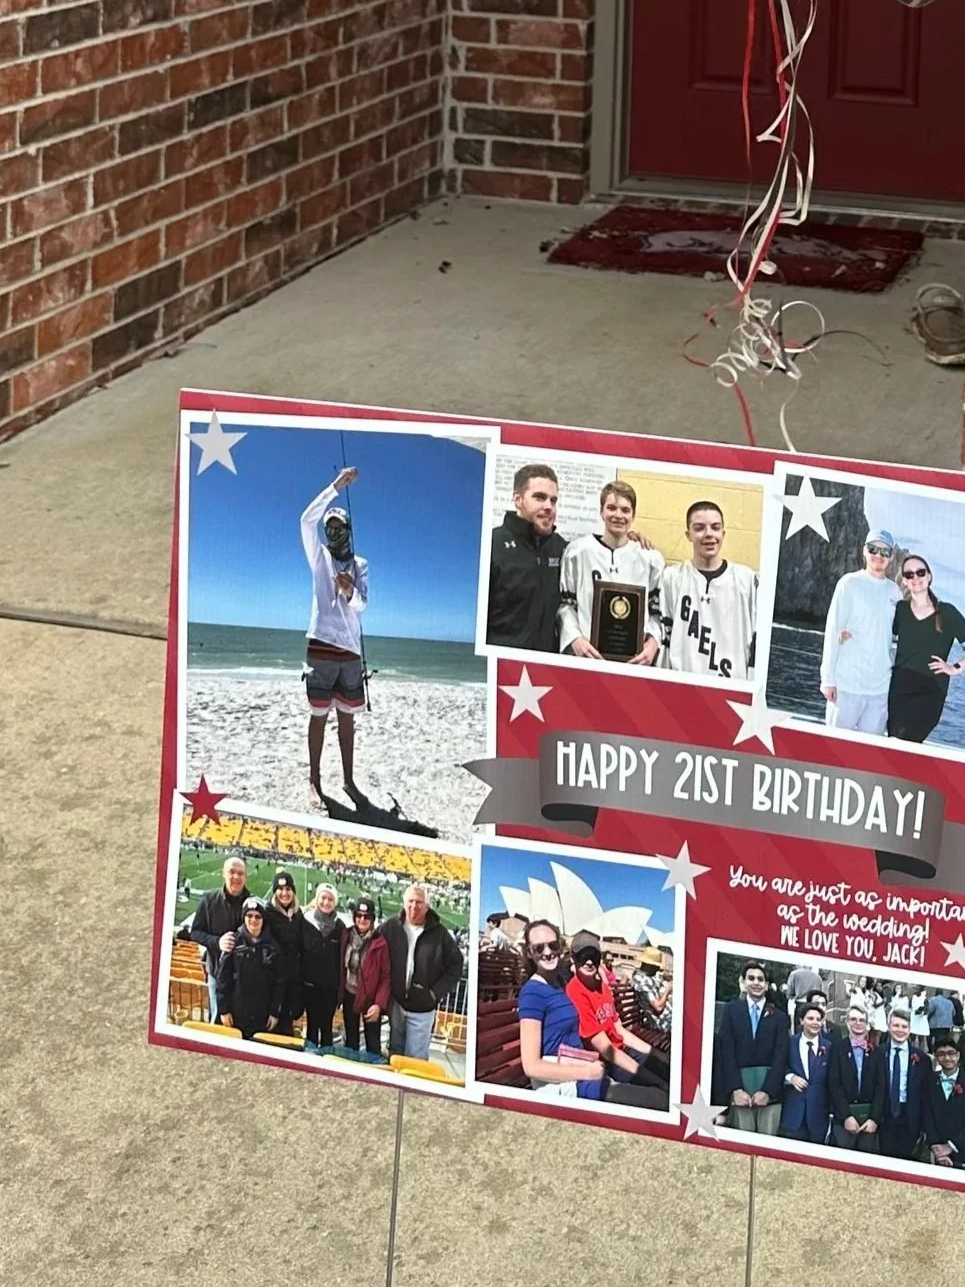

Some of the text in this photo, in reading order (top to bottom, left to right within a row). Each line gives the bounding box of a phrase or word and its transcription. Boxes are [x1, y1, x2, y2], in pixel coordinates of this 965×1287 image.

[680, 594, 733, 679] GAELS
[555, 740, 926, 840] HAPPY 21ST BIRTHDAY!
[728, 864, 768, 892] You
[771, 876, 806, 897] are
[804, 880, 852, 906] just
[854, 889, 883, 910] as
[776, 902, 930, 947] as the wedding!
[779, 924, 926, 968] WE LOVE YOU, JACK!
